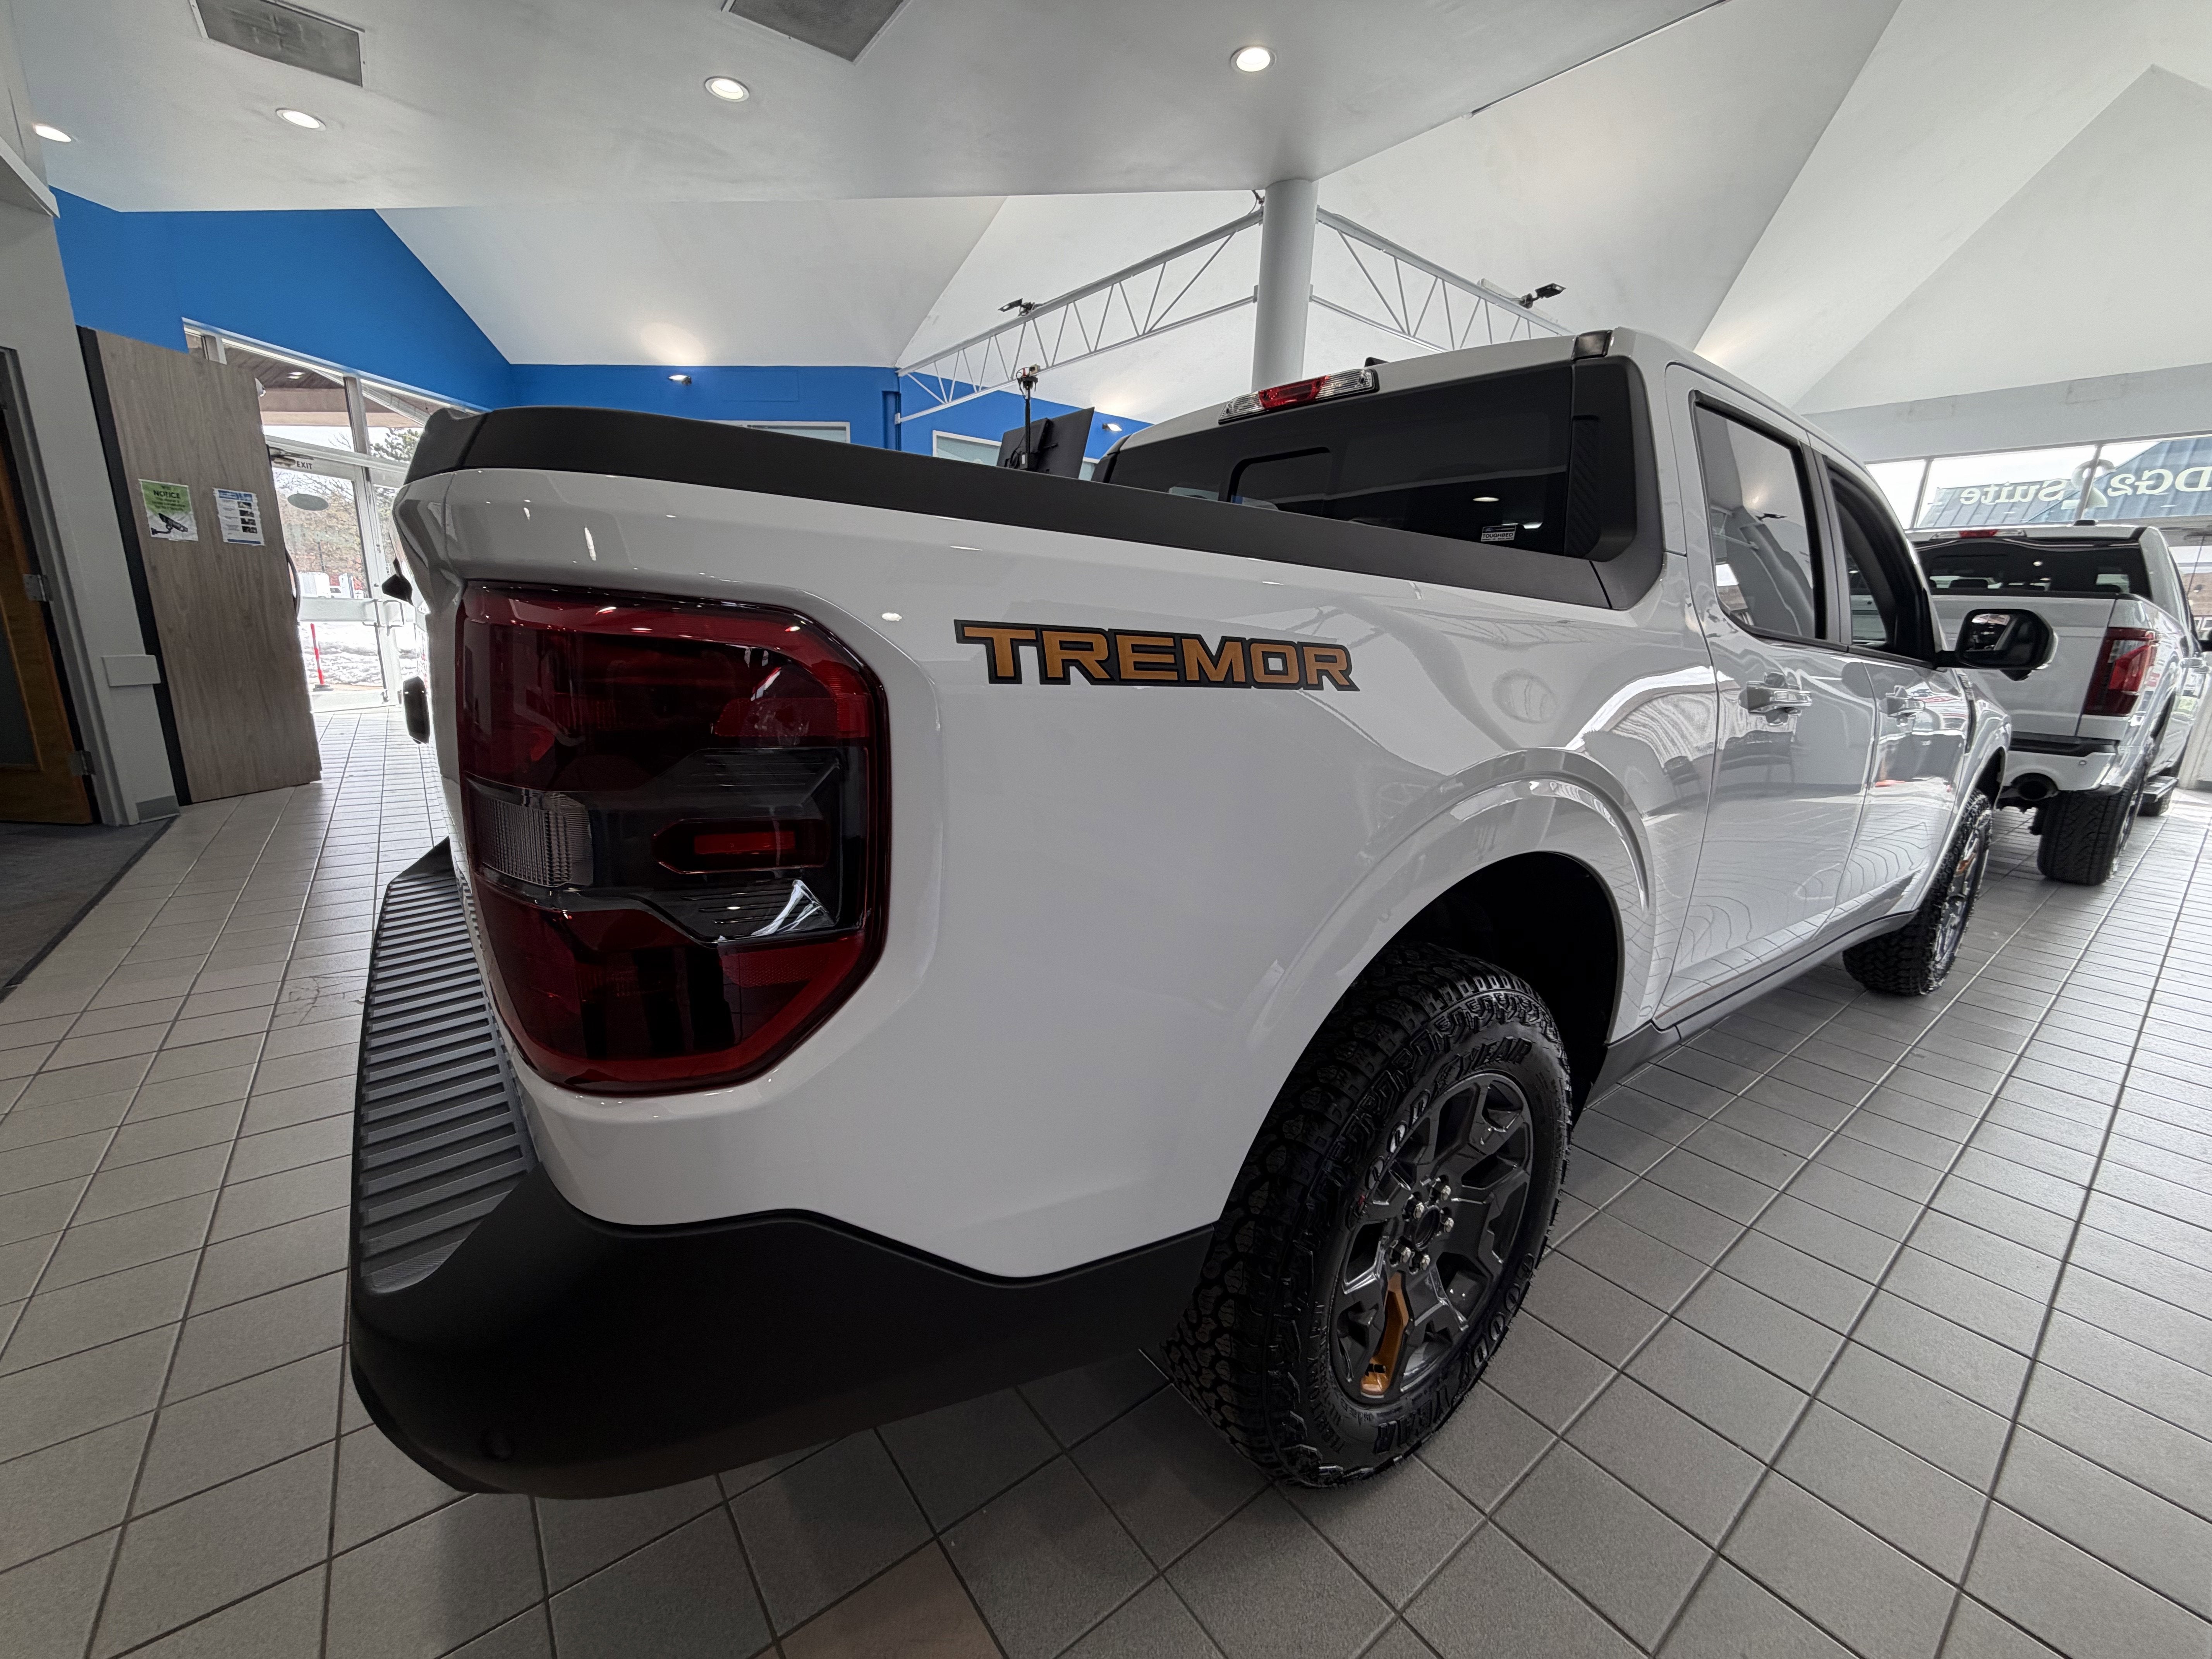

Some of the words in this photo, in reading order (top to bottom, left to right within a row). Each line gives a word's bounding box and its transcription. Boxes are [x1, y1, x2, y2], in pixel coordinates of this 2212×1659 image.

[297, 461, 313, 470] EXIT
[153, 490, 180, 499] NOTICE
[954, 619, 1360, 692] TREMOR
